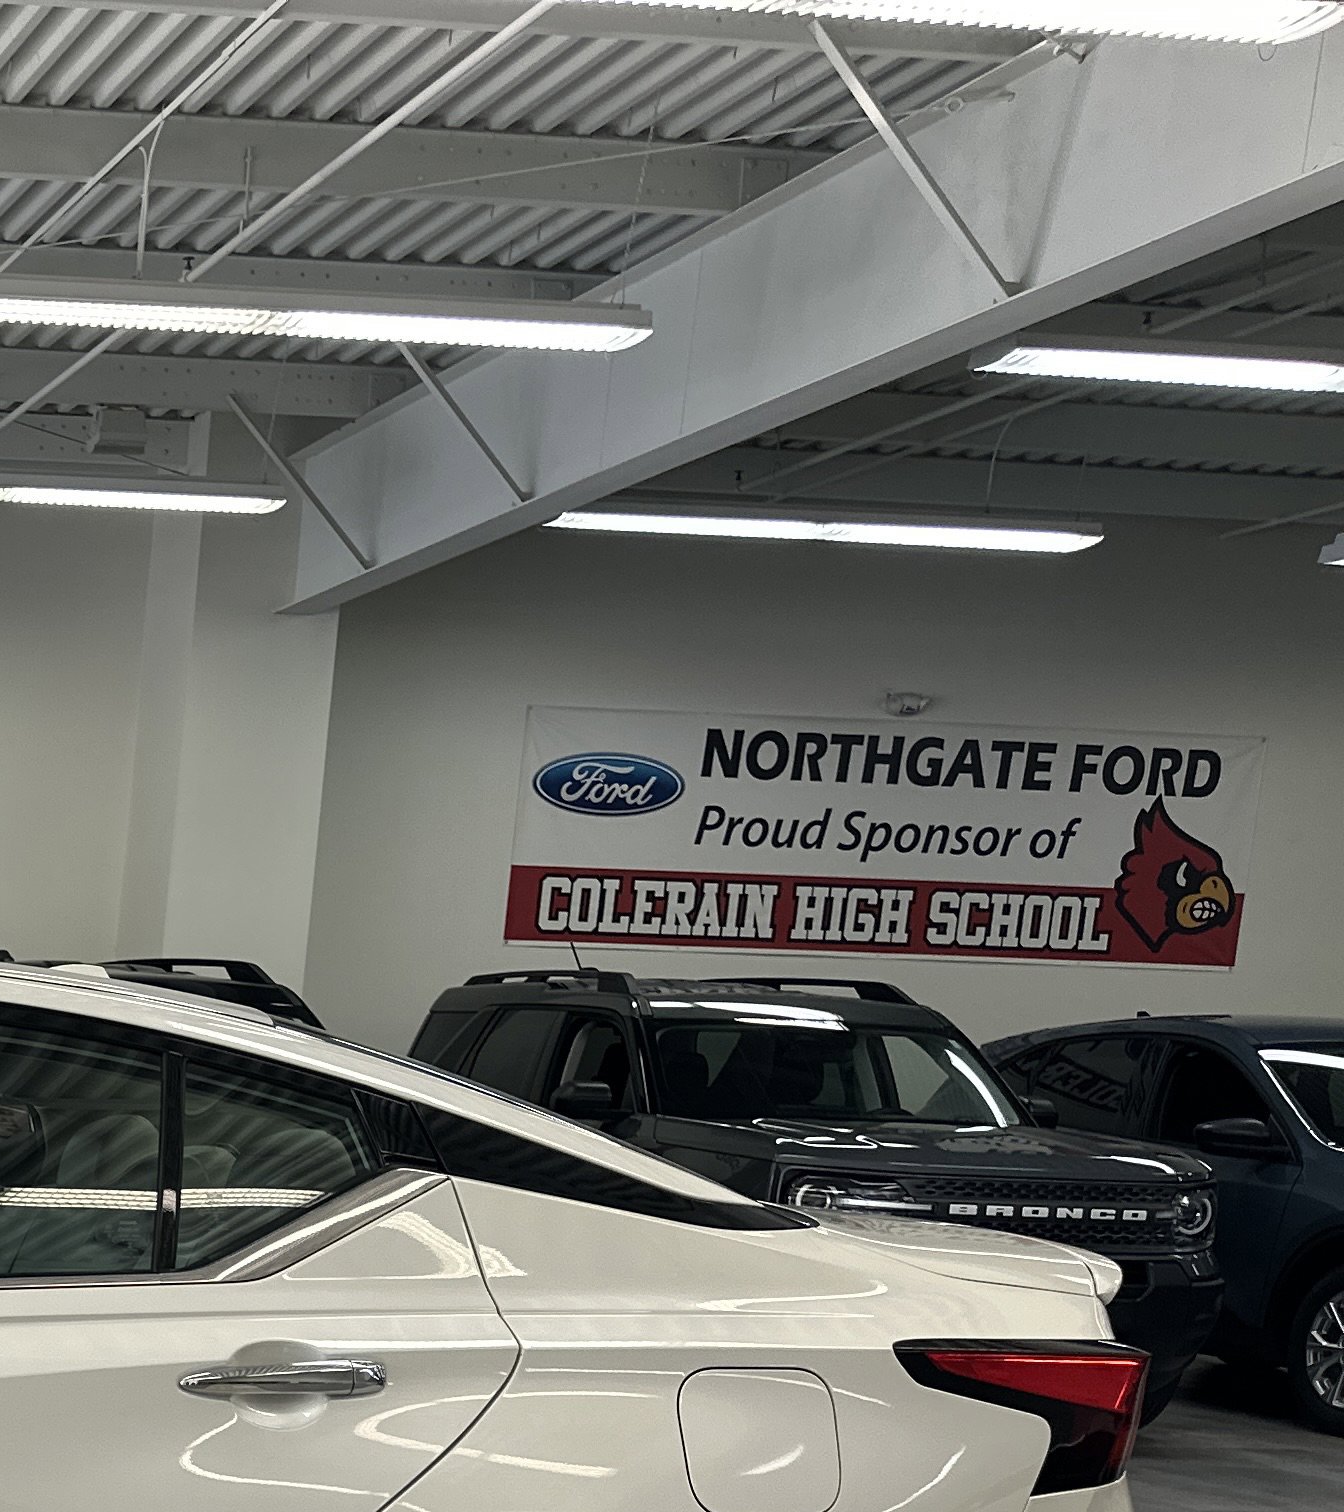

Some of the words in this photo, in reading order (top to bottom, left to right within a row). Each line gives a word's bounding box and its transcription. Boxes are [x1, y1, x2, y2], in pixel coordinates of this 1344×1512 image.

[699, 728, 1058, 793] NORTHGATE
[1069, 743, 1223, 800] FORD
[694, 804, 833, 851] Proud
[837, 808, 1022, 863] Sponsor
[1028, 817, 1082, 860] of
[536, 874, 776, 942] COLERAIN
[789, 882, 916, 946] HIGH
[925, 890, 1111, 954] SCHOOL
[947, 1202, 1149, 1221] BRONCO
